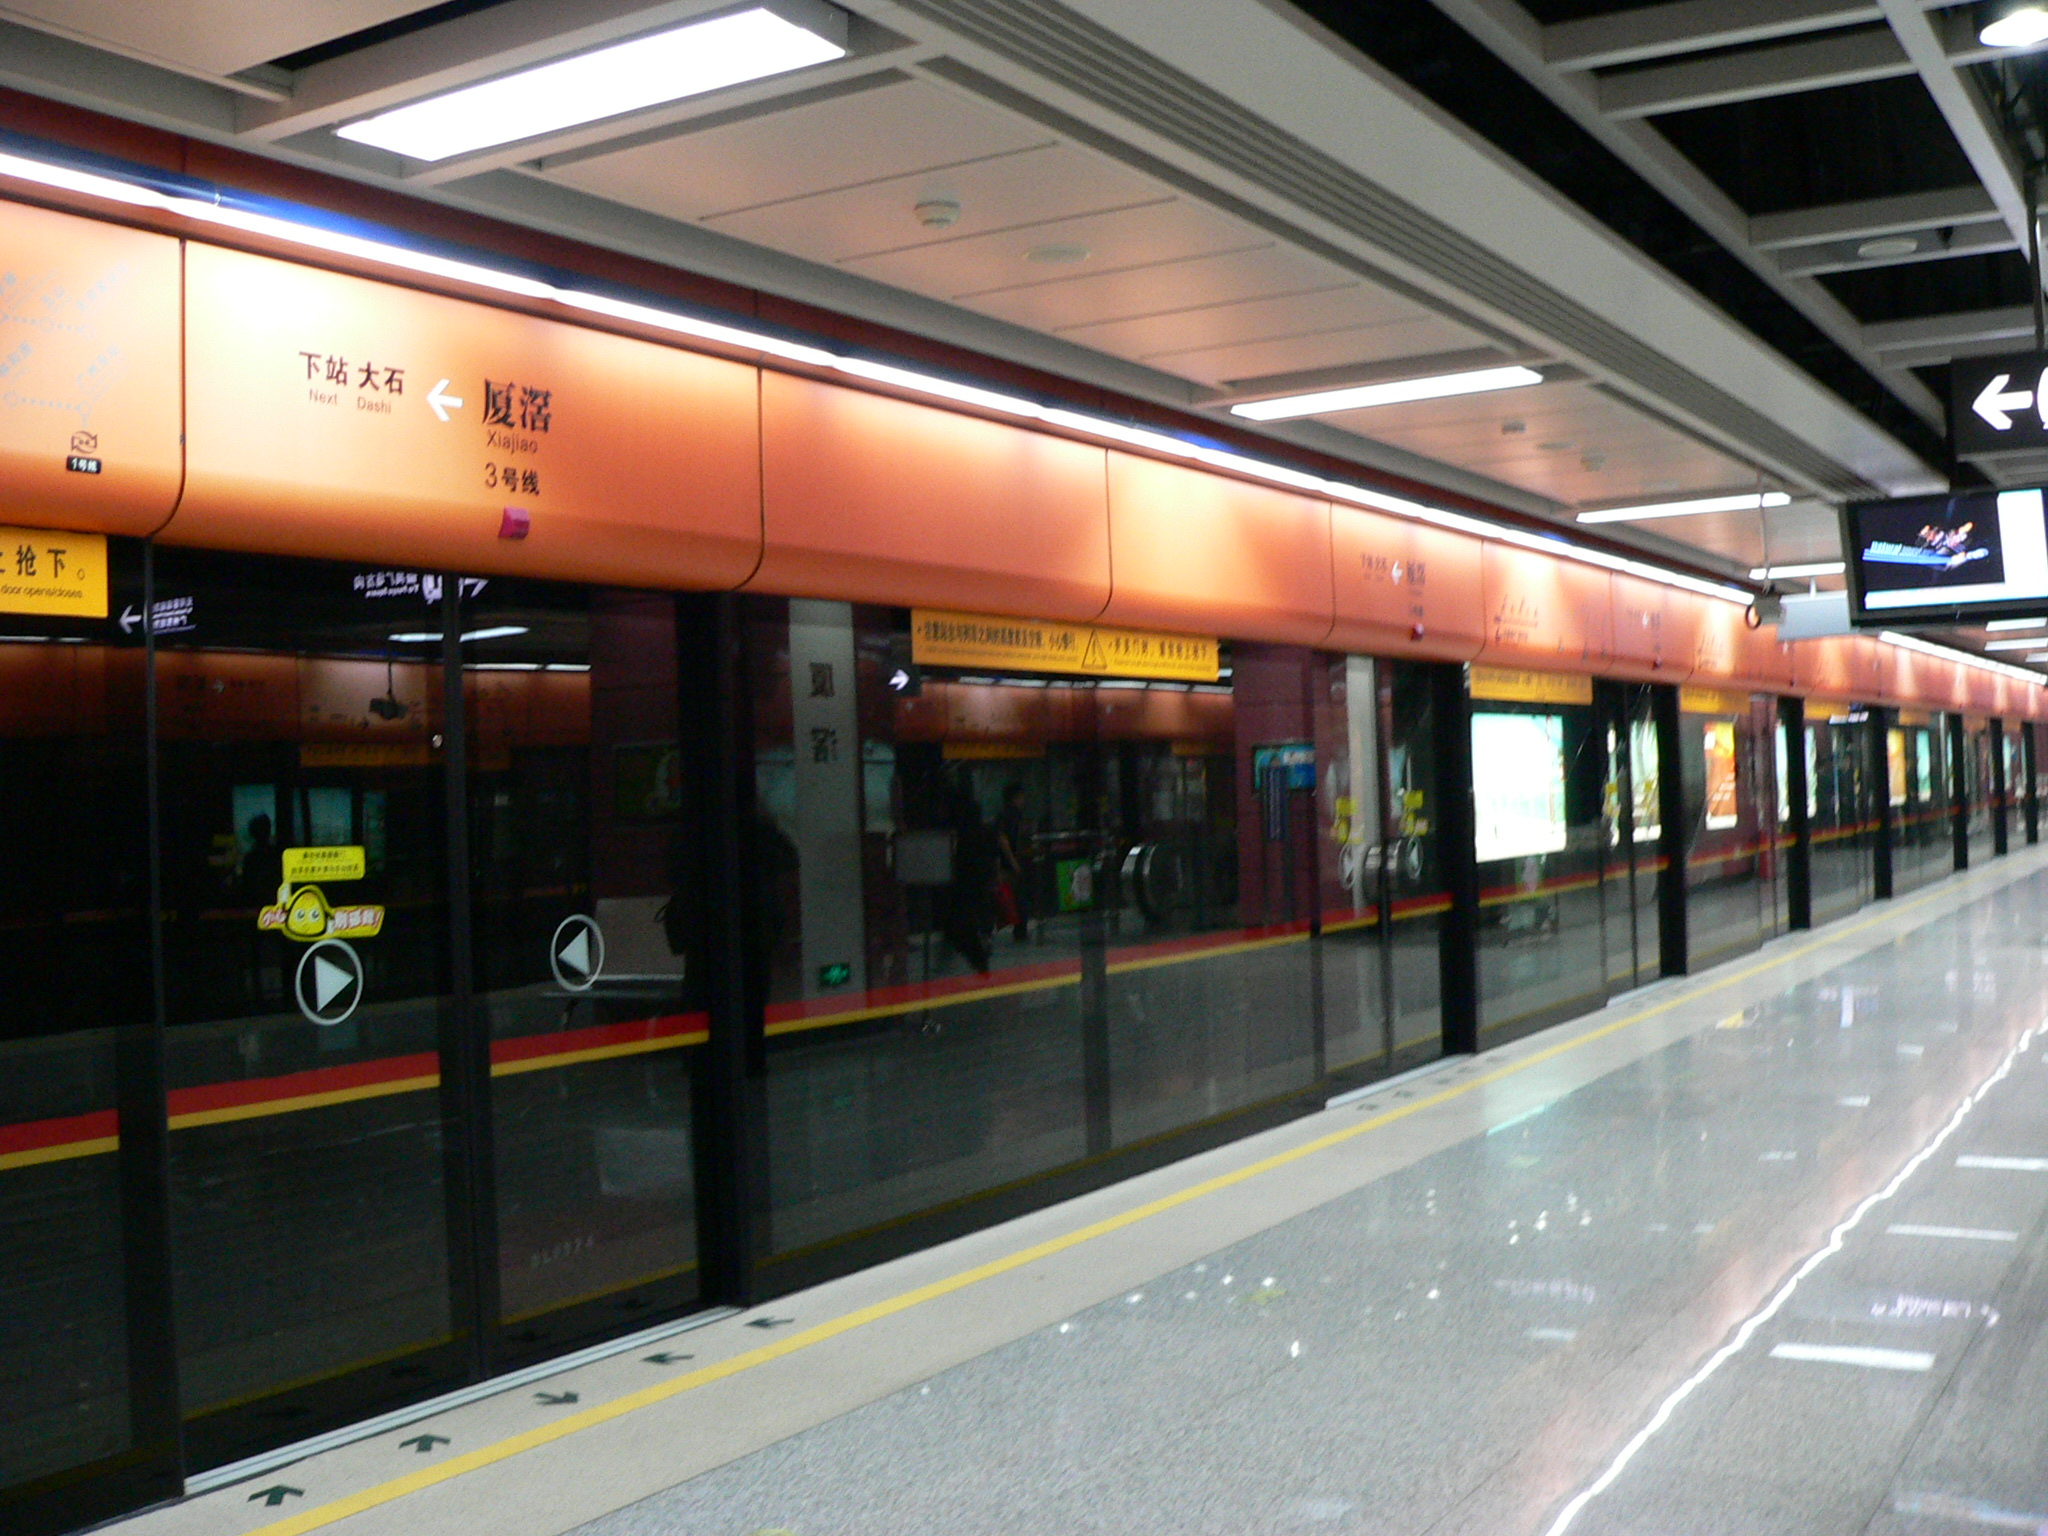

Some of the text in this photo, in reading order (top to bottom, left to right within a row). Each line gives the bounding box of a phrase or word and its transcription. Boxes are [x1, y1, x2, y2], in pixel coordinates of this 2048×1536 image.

[299, 350, 405, 396] 下站 大石
[309, 388, 392, 414] Next Dashi
[487, 430, 538, 455] Xiajiao
[485, 462, 540, 497] 3号线
